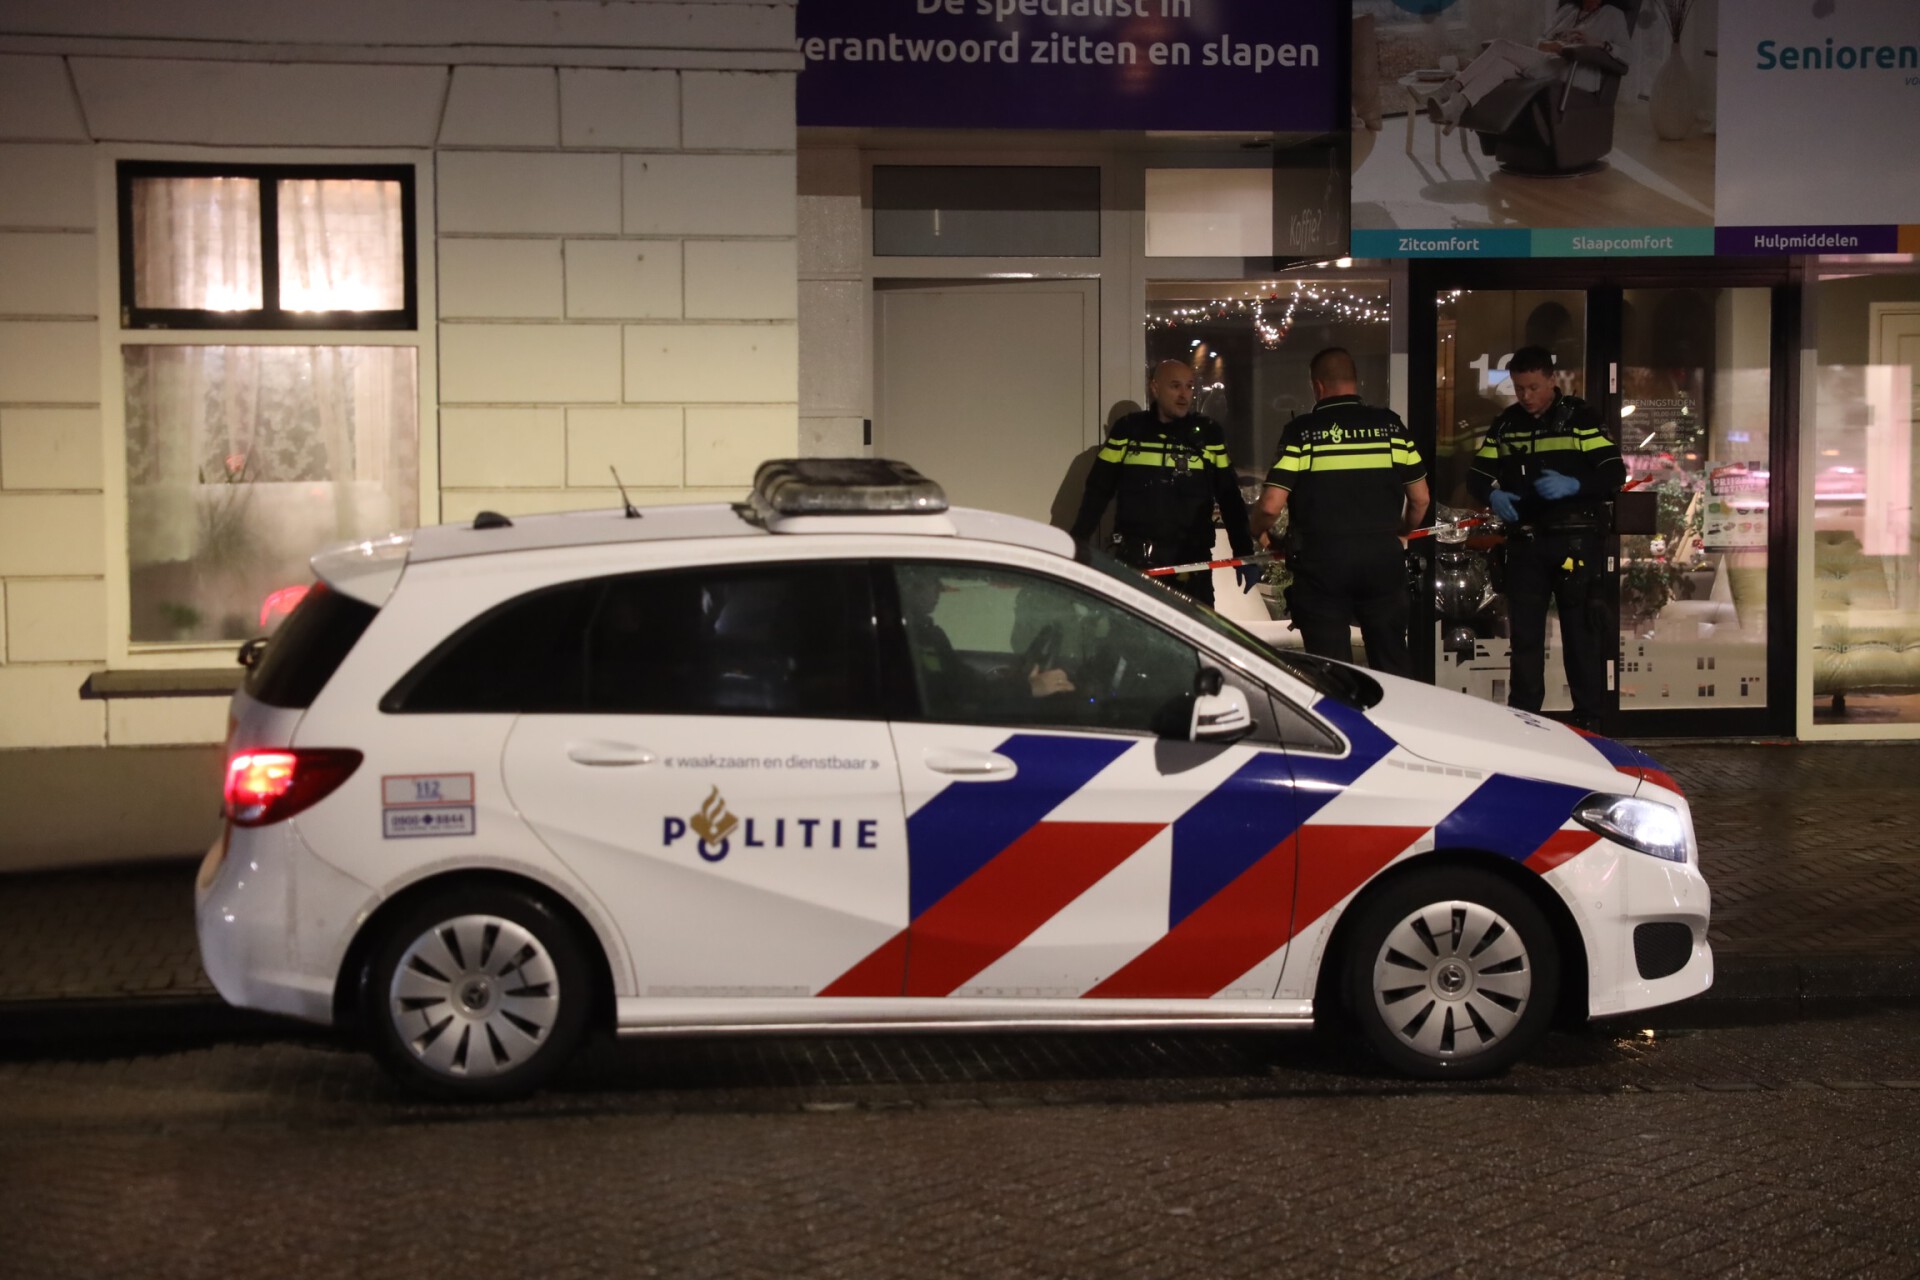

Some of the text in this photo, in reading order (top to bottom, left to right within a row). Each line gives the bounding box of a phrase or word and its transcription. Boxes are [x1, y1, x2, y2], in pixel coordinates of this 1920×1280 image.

[1030, 32, 1137, 64] zitten
[1149, 41, 1191, 65] en
[1202, 34, 1319, 73] slapen
[1757, 37, 1918, 70] Senioren
[1398, 236, 1480, 251] Zitcomfort
[1572, 235, 1673, 252] Slaapcomfort
[1754, 233, 1858, 250] Hulpmiddelen
[1322, 424, 1381, 443] POLITIE
[677, 755, 760, 768] waakzaam
[763, 757, 783, 769] en
[785, 756, 866, 770] dienstbaar
[415, 780, 441, 799] 112
[663, 800, 878, 862] POLITIE
